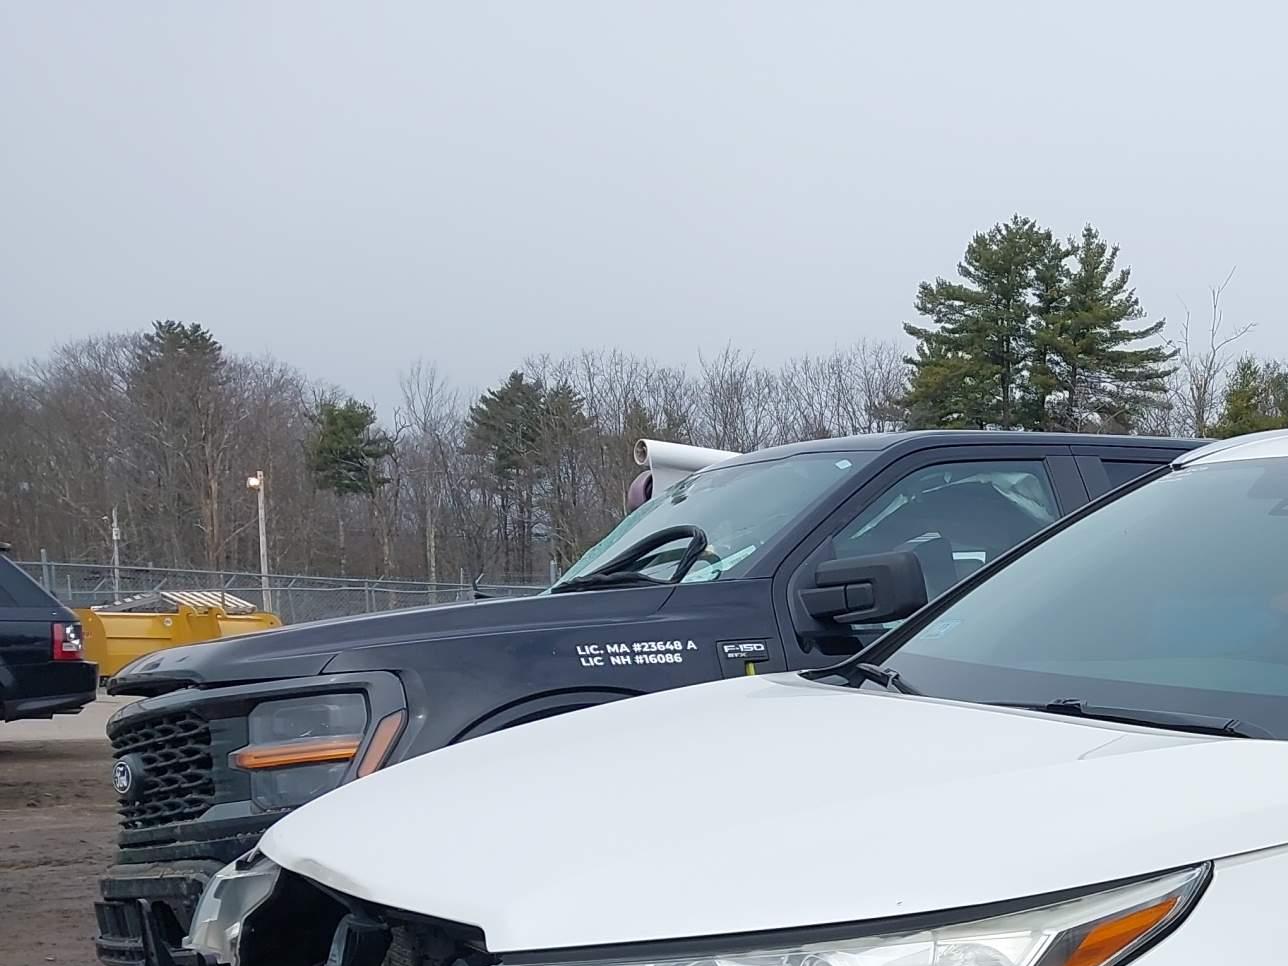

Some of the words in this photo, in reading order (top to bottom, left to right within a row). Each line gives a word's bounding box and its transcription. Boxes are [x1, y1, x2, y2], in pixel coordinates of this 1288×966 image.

[576, 644, 605, 655] LIC.
[605, 643, 631, 654] MA
[631, 640, 683, 654] #23648
[686, 640, 698, 650] A
[723, 643, 765, 653] F-150
[580, 656, 605, 666] LIC
[610, 655, 632, 665] NH
[634, 653, 683, 665] #16086
